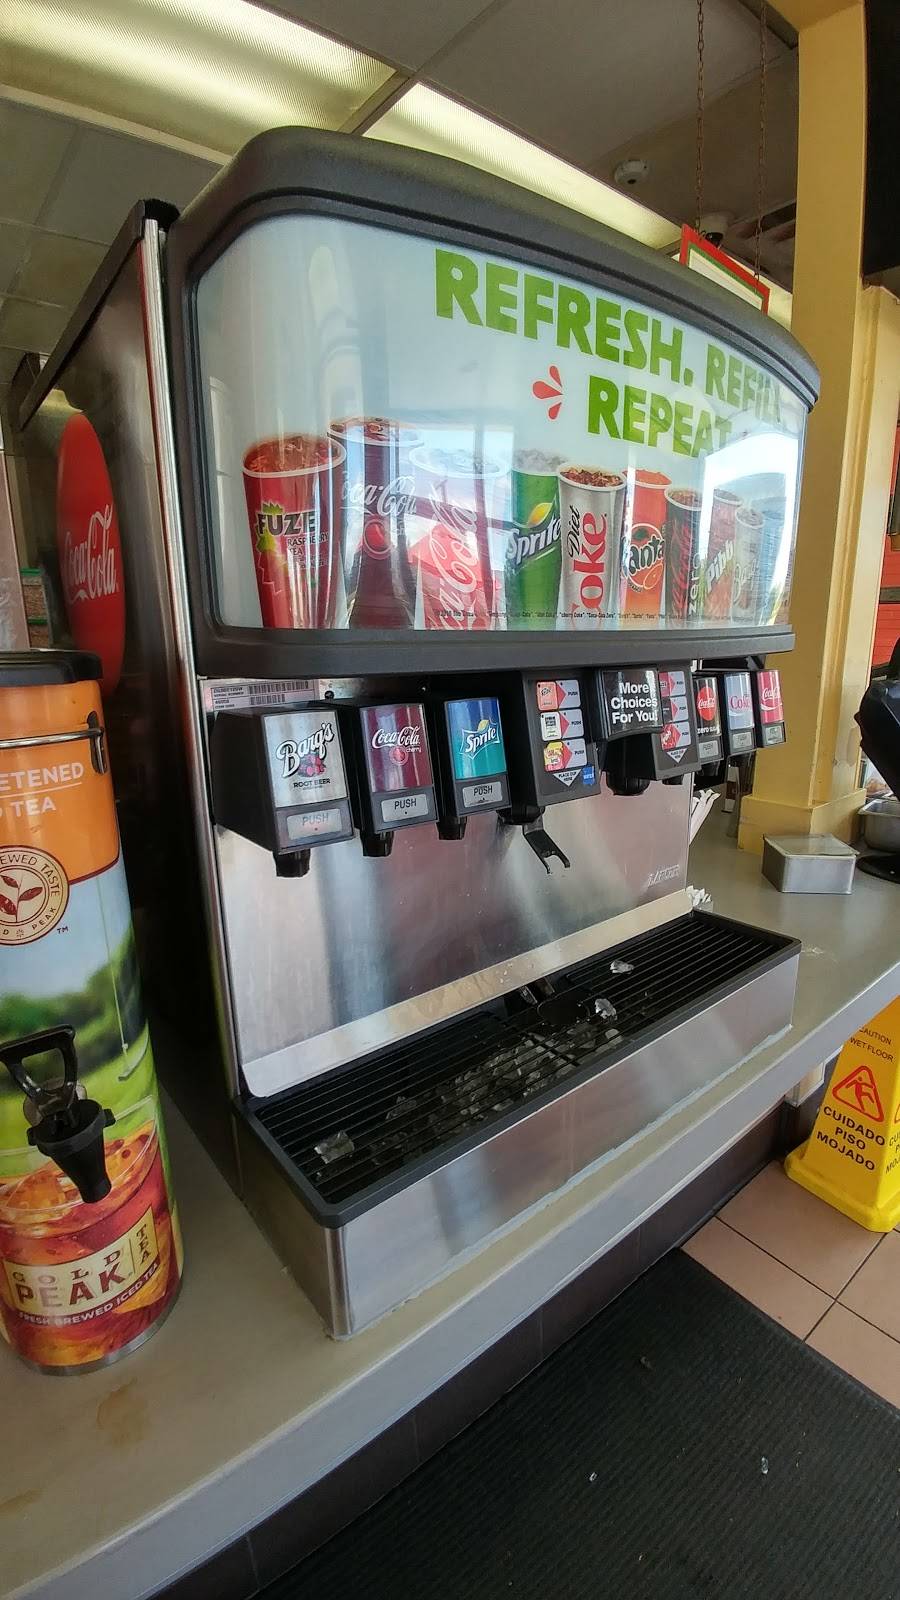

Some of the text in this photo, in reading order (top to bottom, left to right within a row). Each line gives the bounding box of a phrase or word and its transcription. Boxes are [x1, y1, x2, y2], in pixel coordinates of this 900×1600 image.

[435, 248, 693, 387] REFRESH.
[257, 511, 318, 535] FUZE
[567, 505, 580, 557] Diet
[506, 513, 560, 565] Sprite
[619, 681, 649, 694] More
[611, 696, 658, 709] Choices
[612, 711, 633, 724] For
[277, 722, 335, 778] Barq's
[372, 726, 420, 749] Coca-Cola
[464, 726, 496, 753] Sprite
[293, 780, 313, 789] ROOT
[314, 778, 331, 786] BEER
[473, 785, 493, 797] PUSH
[10, 796, 56, 817] TEA
[394, 798, 417, 810] PUSH
[302, 813, 329, 826] PUSH
[40, 863, 60, 897] TASTE
[850, 1036, 894, 1062] WET FLOOR
[823, 1105, 885, 1146] CUIDADO
[835, 1126, 866, 1150] PISO
[816, 1130, 876, 1171] MOJADO
[136, 1223, 151, 1266] TEA
[12, 1250, 121, 1284] GOLD
[15, 1262, 126, 1308] PEAK
[18, 1263, 159, 1326] FRESH BREWED ICED TEA
